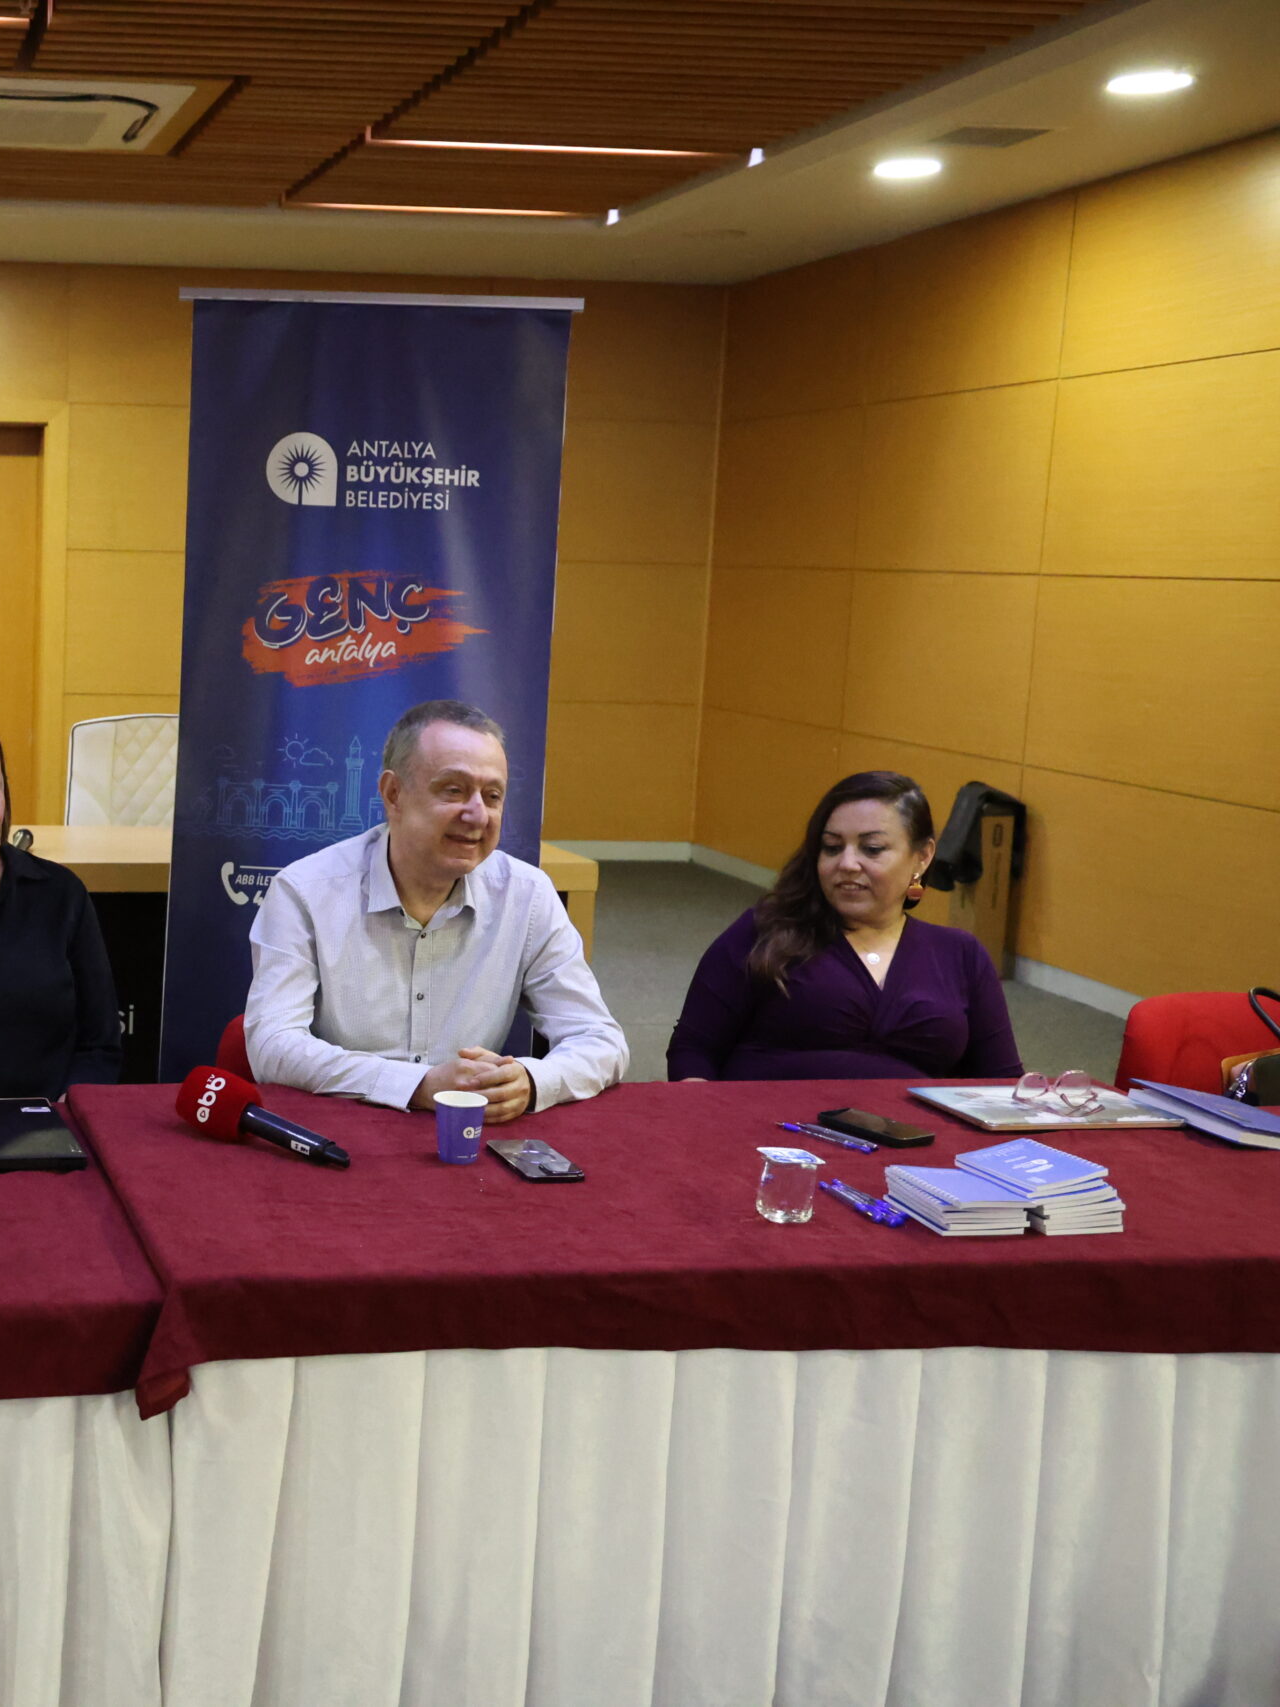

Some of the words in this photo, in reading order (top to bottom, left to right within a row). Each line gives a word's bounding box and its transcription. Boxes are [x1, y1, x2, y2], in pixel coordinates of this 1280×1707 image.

[346, 440, 437, 460] ANTALYA
[346, 461, 481, 489] BÜYÜKŞEHİR
[345, 489, 450, 511] BELEDİYESİ
[253, 576, 430, 649] GENÇ
[304, 631, 397, 668] antalya
[235, 874, 255, 886] ABB
